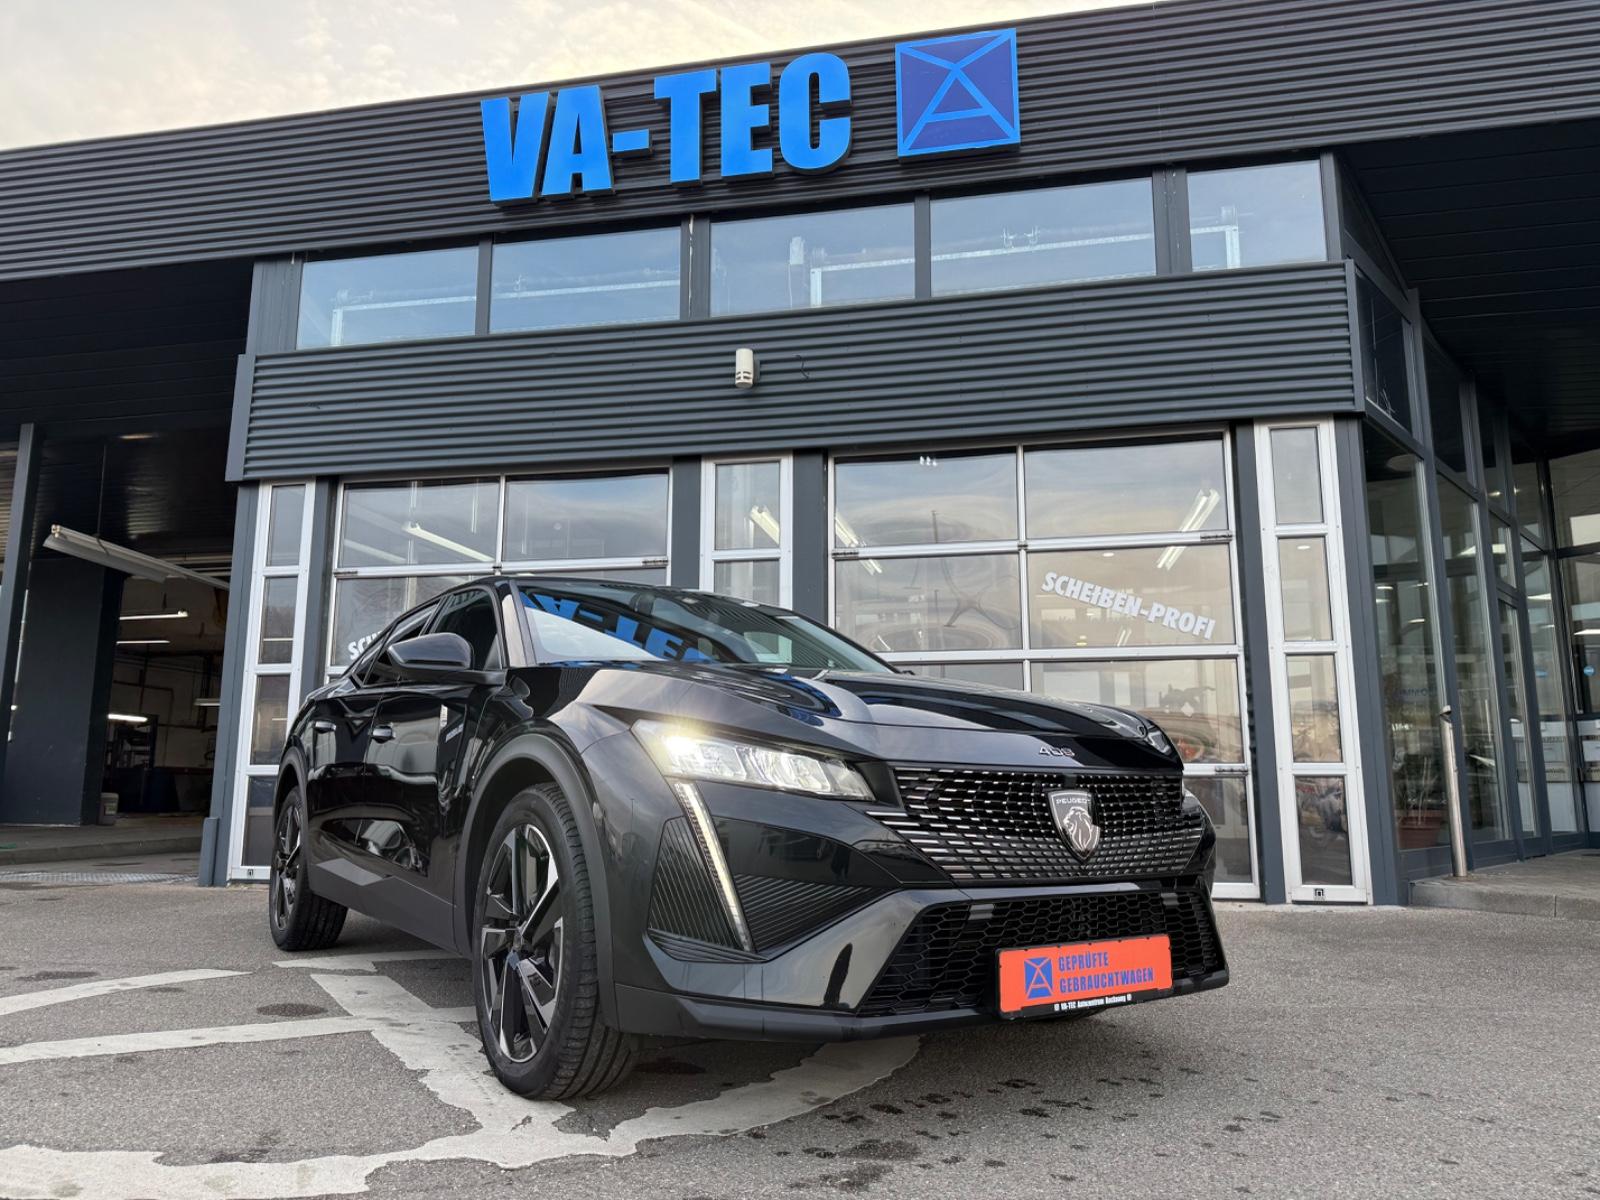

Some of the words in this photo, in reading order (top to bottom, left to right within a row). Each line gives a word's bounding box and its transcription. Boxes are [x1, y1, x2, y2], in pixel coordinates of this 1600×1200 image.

[480, 52, 852, 203] VA-TEC
[1041, 572, 1216, 640] SCHEIBEN-PROFI
[1059, 951, 1108, 971] GEPRÜFTE
[1060, 968, 1153, 993] GEBRAUCHTWAGEN
